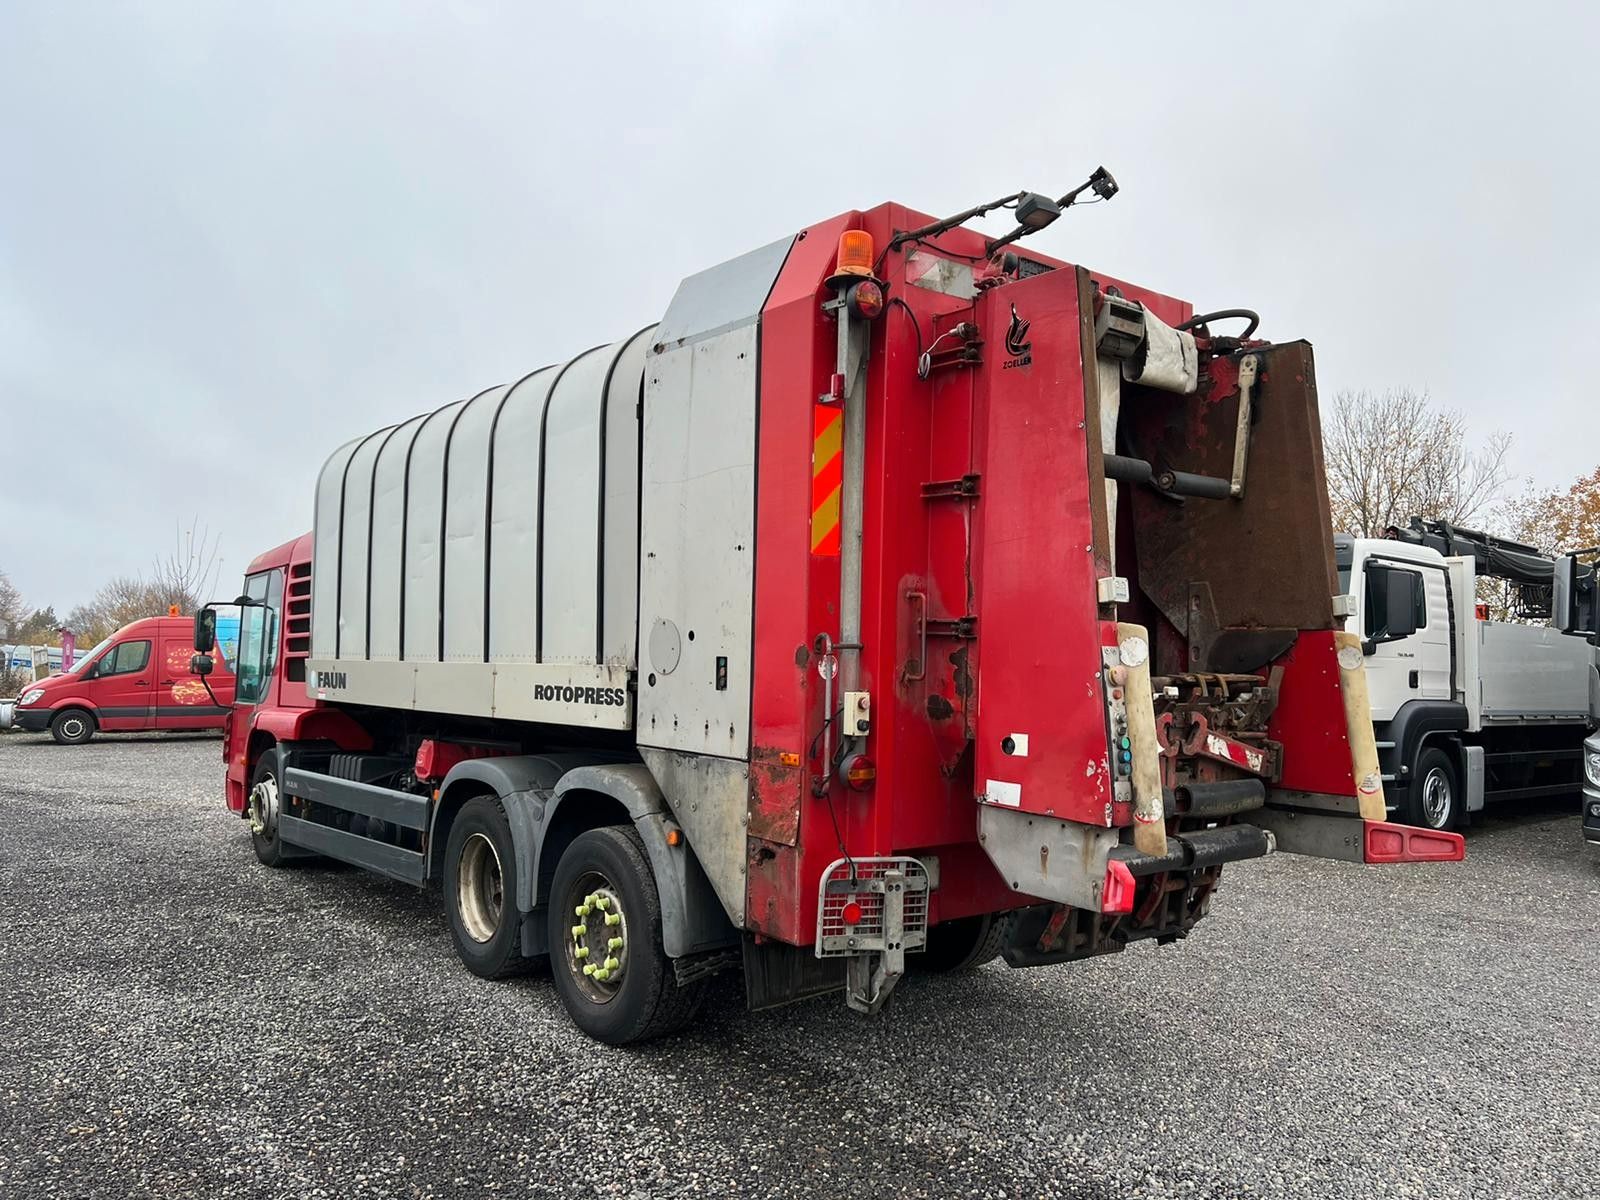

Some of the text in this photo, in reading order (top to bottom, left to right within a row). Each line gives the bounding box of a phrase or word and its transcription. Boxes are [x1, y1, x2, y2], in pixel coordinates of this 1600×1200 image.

[1003, 356, 1032, 370] ZOELLER
[317, 671, 347, 690] FAUN
[534, 684, 625, 707] ROTOPRESS
